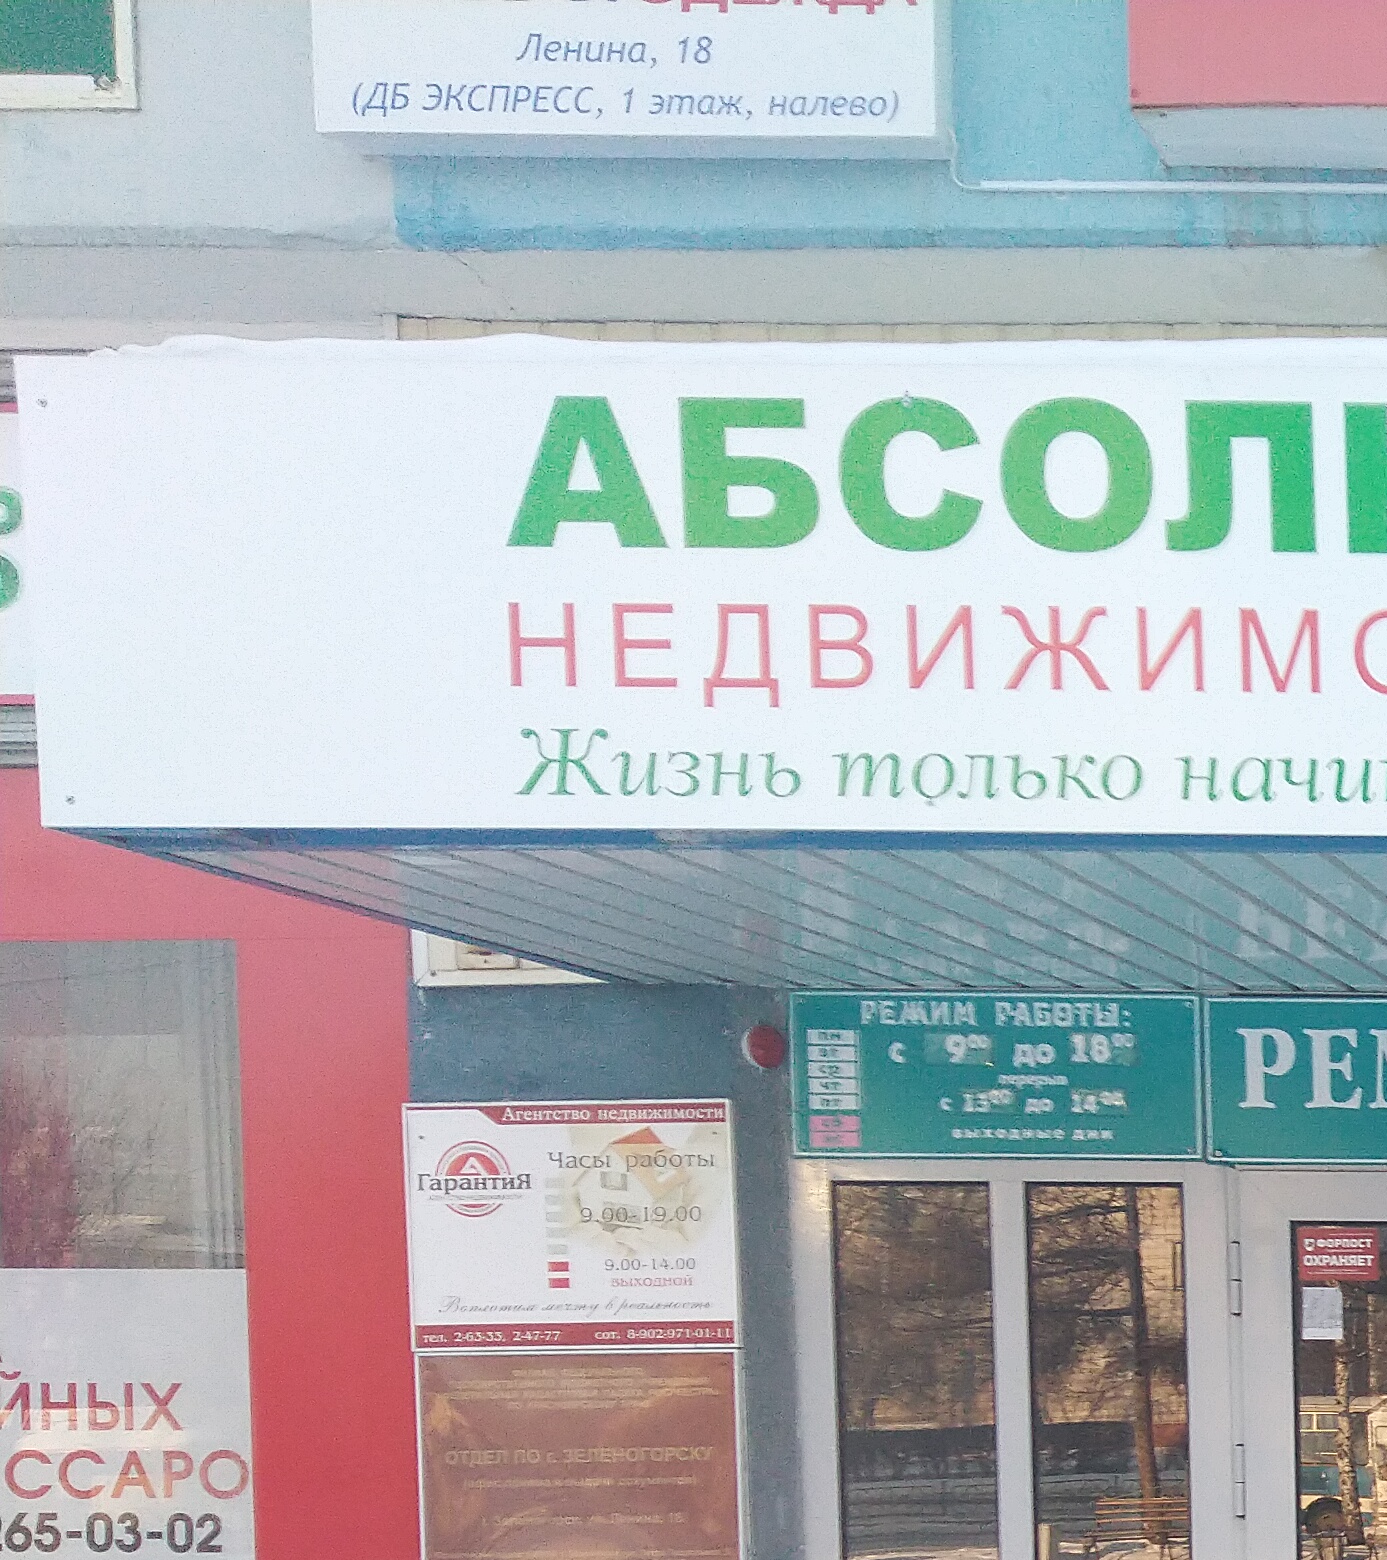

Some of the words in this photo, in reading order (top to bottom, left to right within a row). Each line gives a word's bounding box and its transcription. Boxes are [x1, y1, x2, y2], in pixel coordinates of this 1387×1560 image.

[516, 33, 658, 68] Ленина,
[678, 37, 713, 65] 18
[352, 81, 410, 117] (ДБ
[422, 83, 604, 119] ЭКСПРЕСС,
[622, 89, 634, 115] 1
[649, 91, 754, 119] этаж,
[768, 91, 900, 120] налево)
[515, 725, 802, 804] Жизнь
[833, 738, 1144, 807] только
[860, 1000, 977, 1026] РЕЖИМ
[995, 1002, 1131, 1027] РАБОТЫ:
[1012, 1044, 1056, 1068] до
[502, 1106, 591, 1123] Агентство
[598, 1105, 726, 1122] недвижимости
[548, 1151, 611, 1169] Часы
[626, 1150, 715, 1171] работы
[1303, 1254, 1375, 1267] ОХРАНЯЕТ
[4, 1449, 249, 1500] ССАРО
